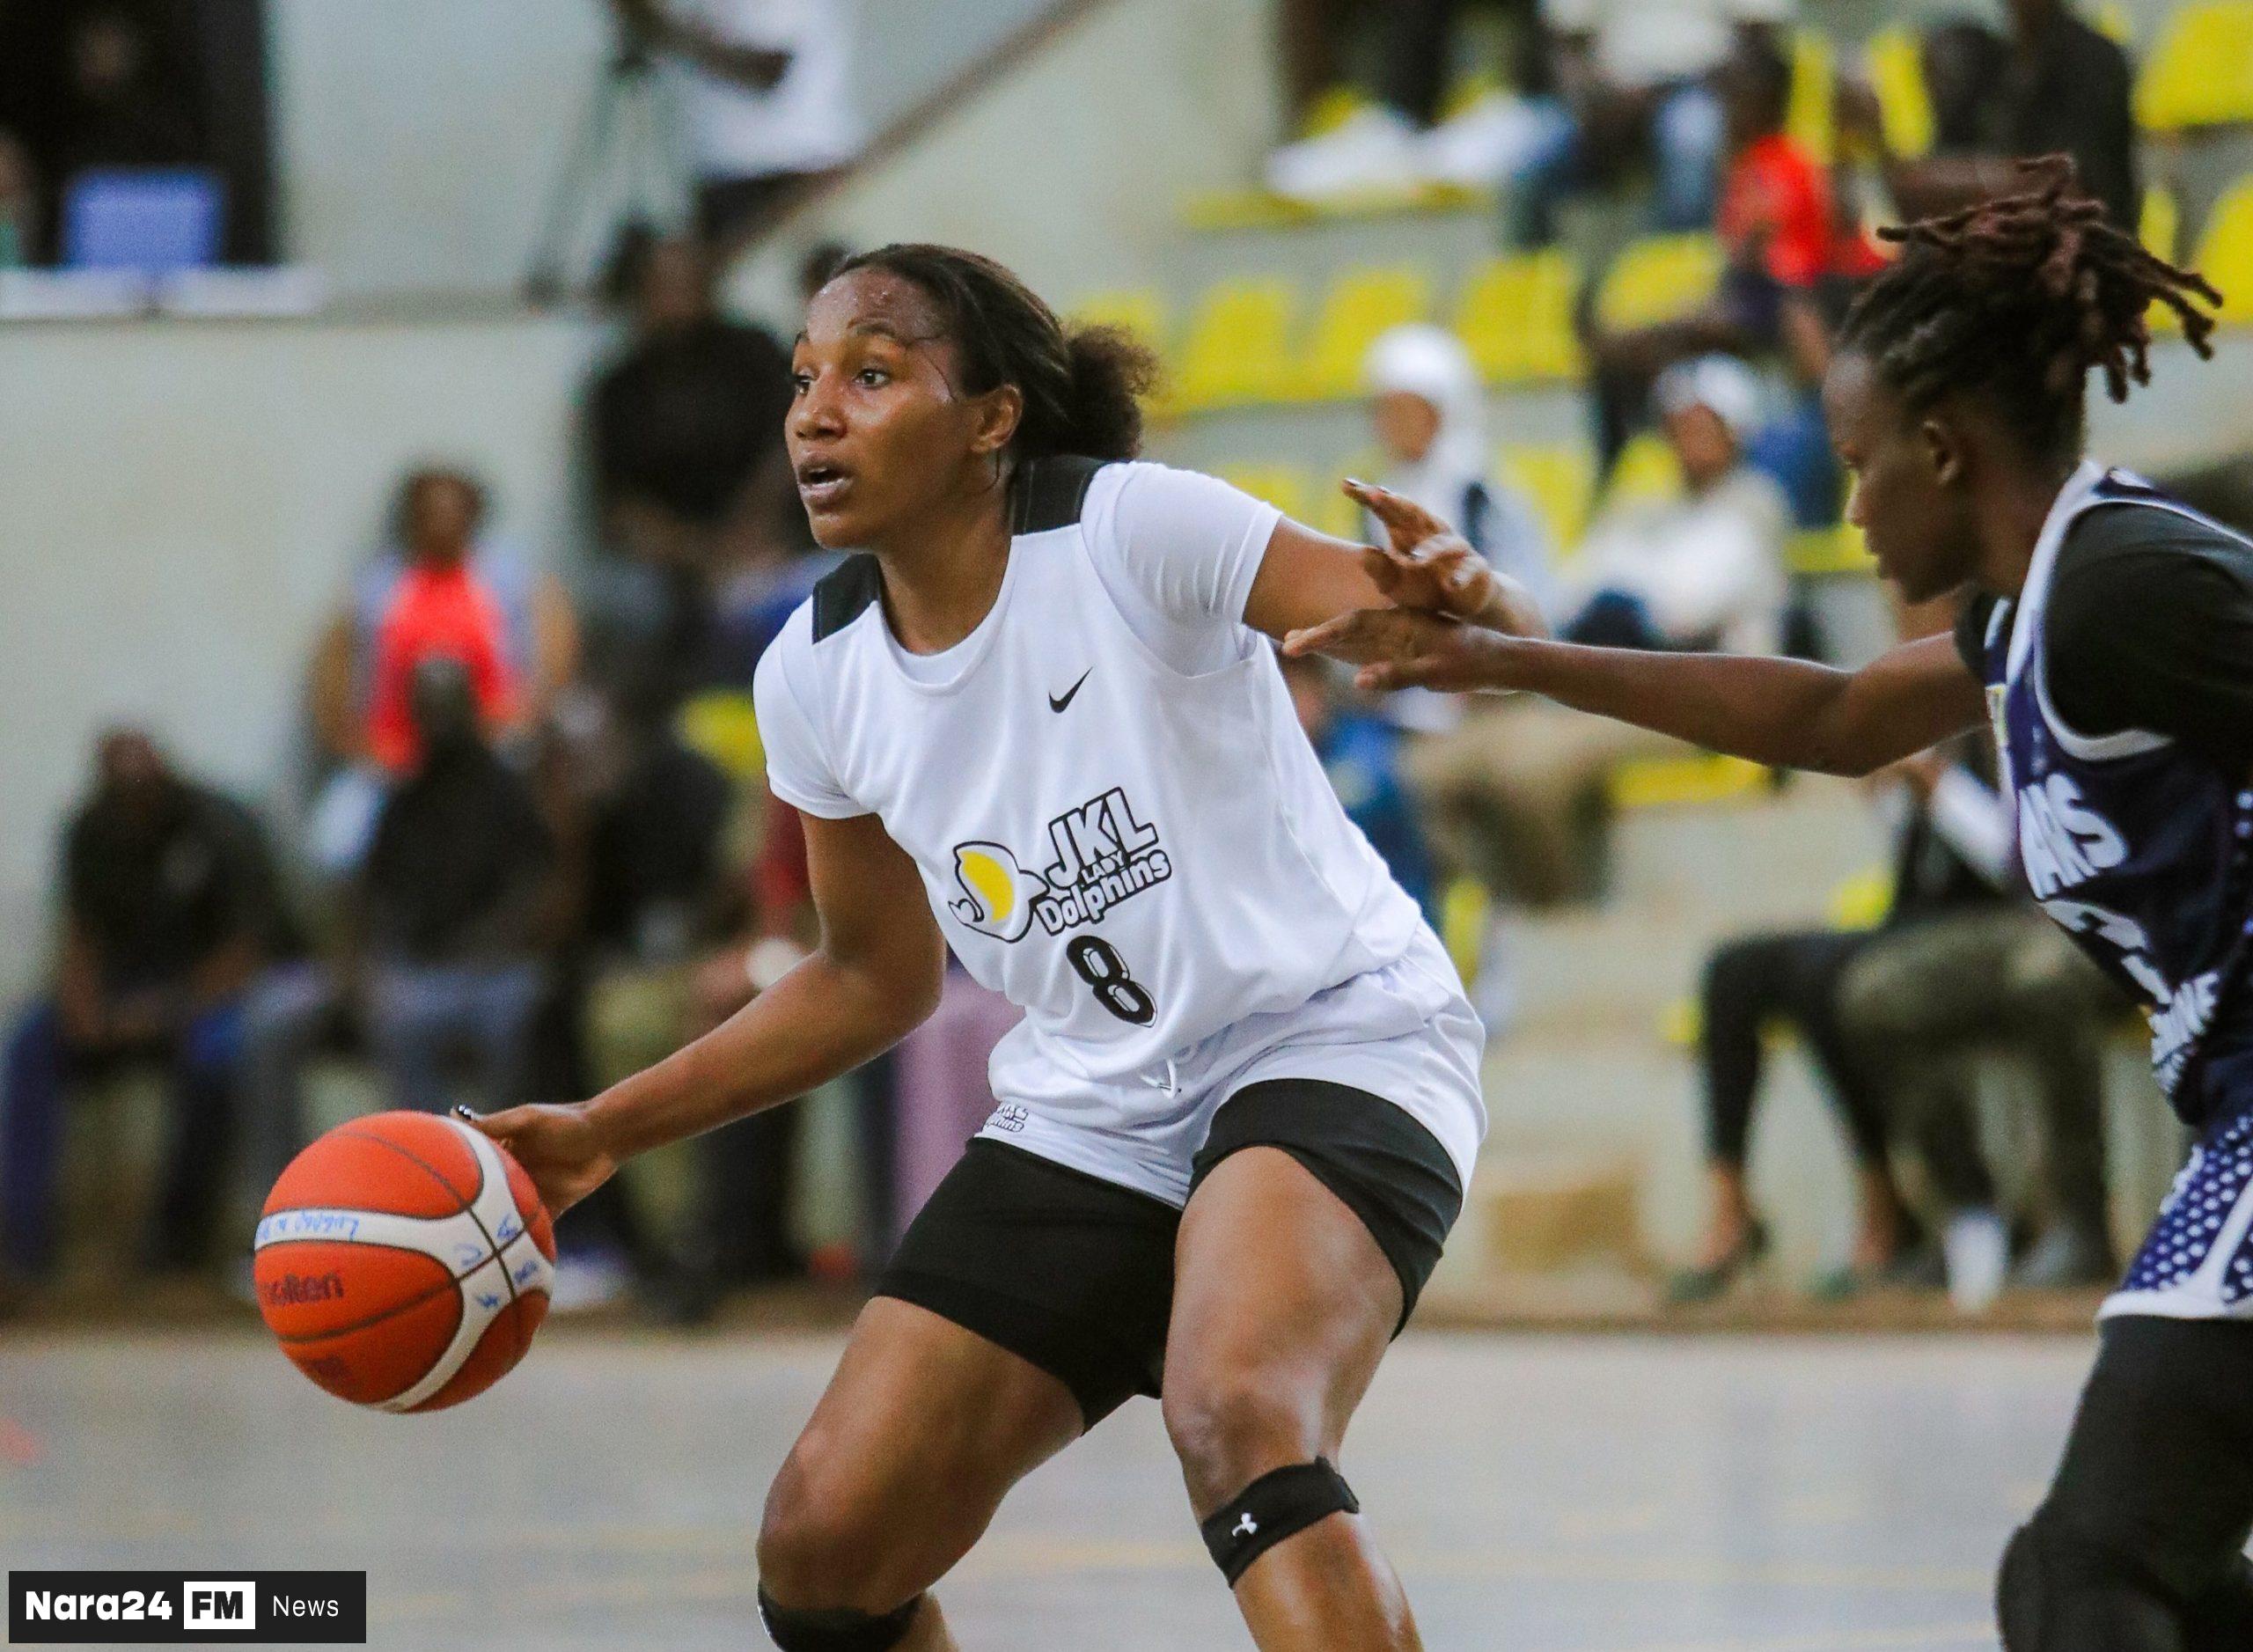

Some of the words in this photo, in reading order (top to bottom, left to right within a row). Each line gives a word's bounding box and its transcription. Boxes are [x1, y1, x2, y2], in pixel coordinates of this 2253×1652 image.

[1046, 787, 1158, 889] JKL
[1081, 850, 1125, 884] LADY
[1033, 850, 1171, 936] Dolphins
[1066, 935, 1157, 1027] 8
